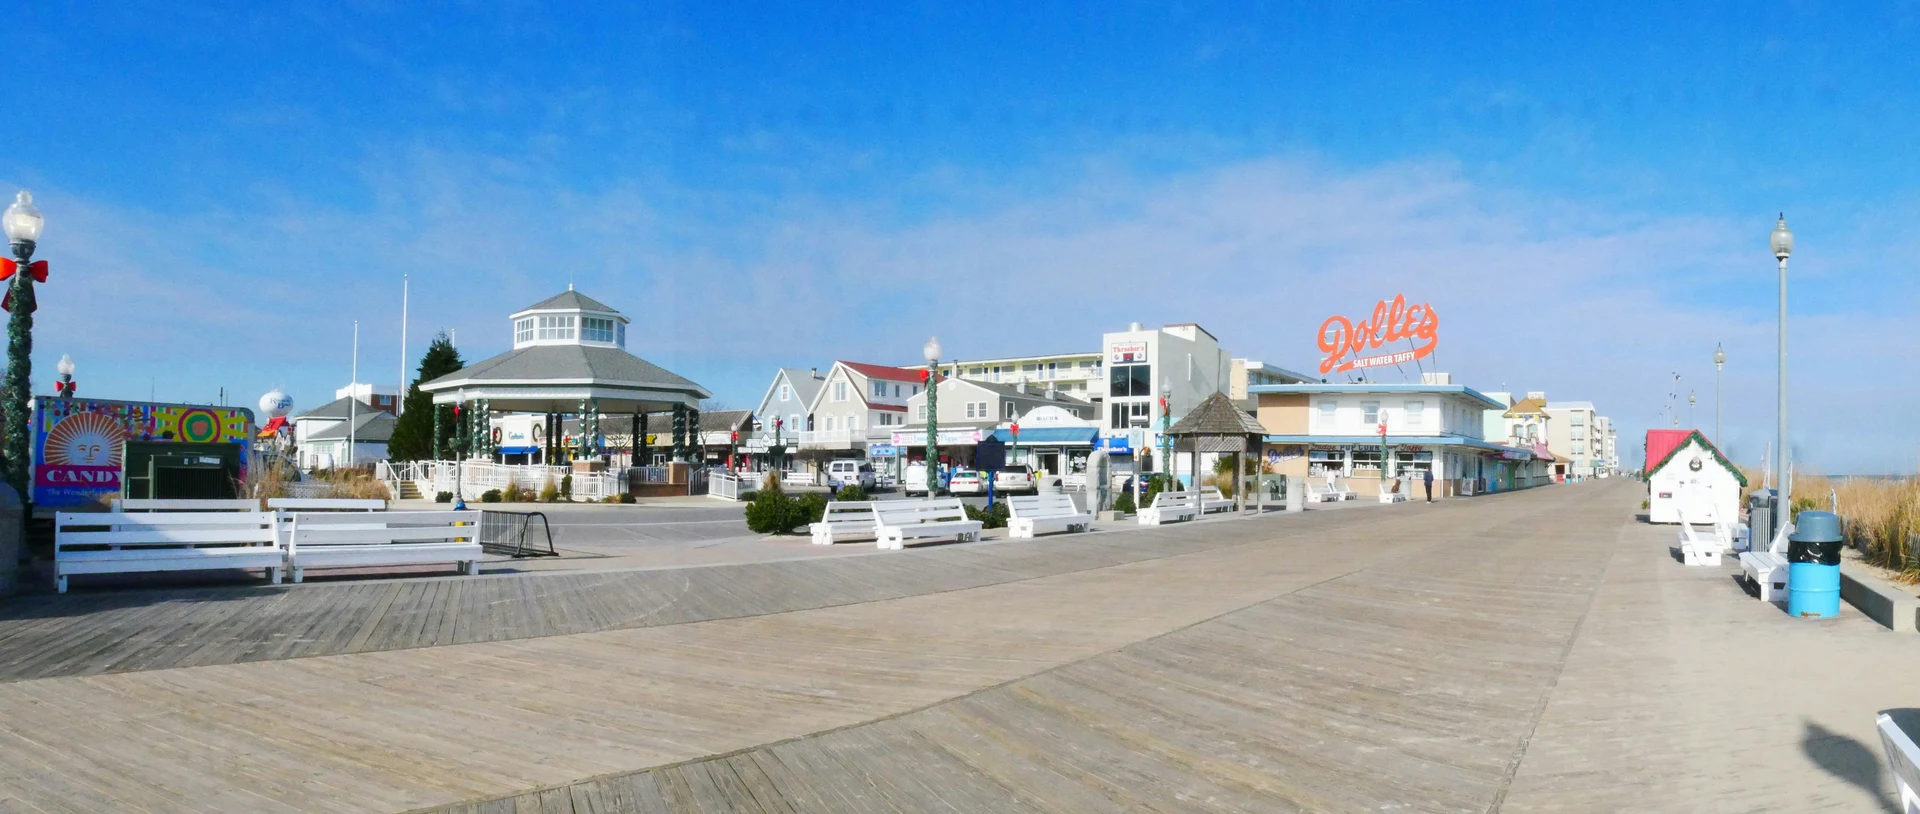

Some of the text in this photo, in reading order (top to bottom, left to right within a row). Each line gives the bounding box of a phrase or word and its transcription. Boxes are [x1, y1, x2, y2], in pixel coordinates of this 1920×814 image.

[1353, 351, 1416, 369] SALT WATER TAFFY
[1400, 443, 1424, 453] Taffy
[46, 469, 122, 483] CANDY
